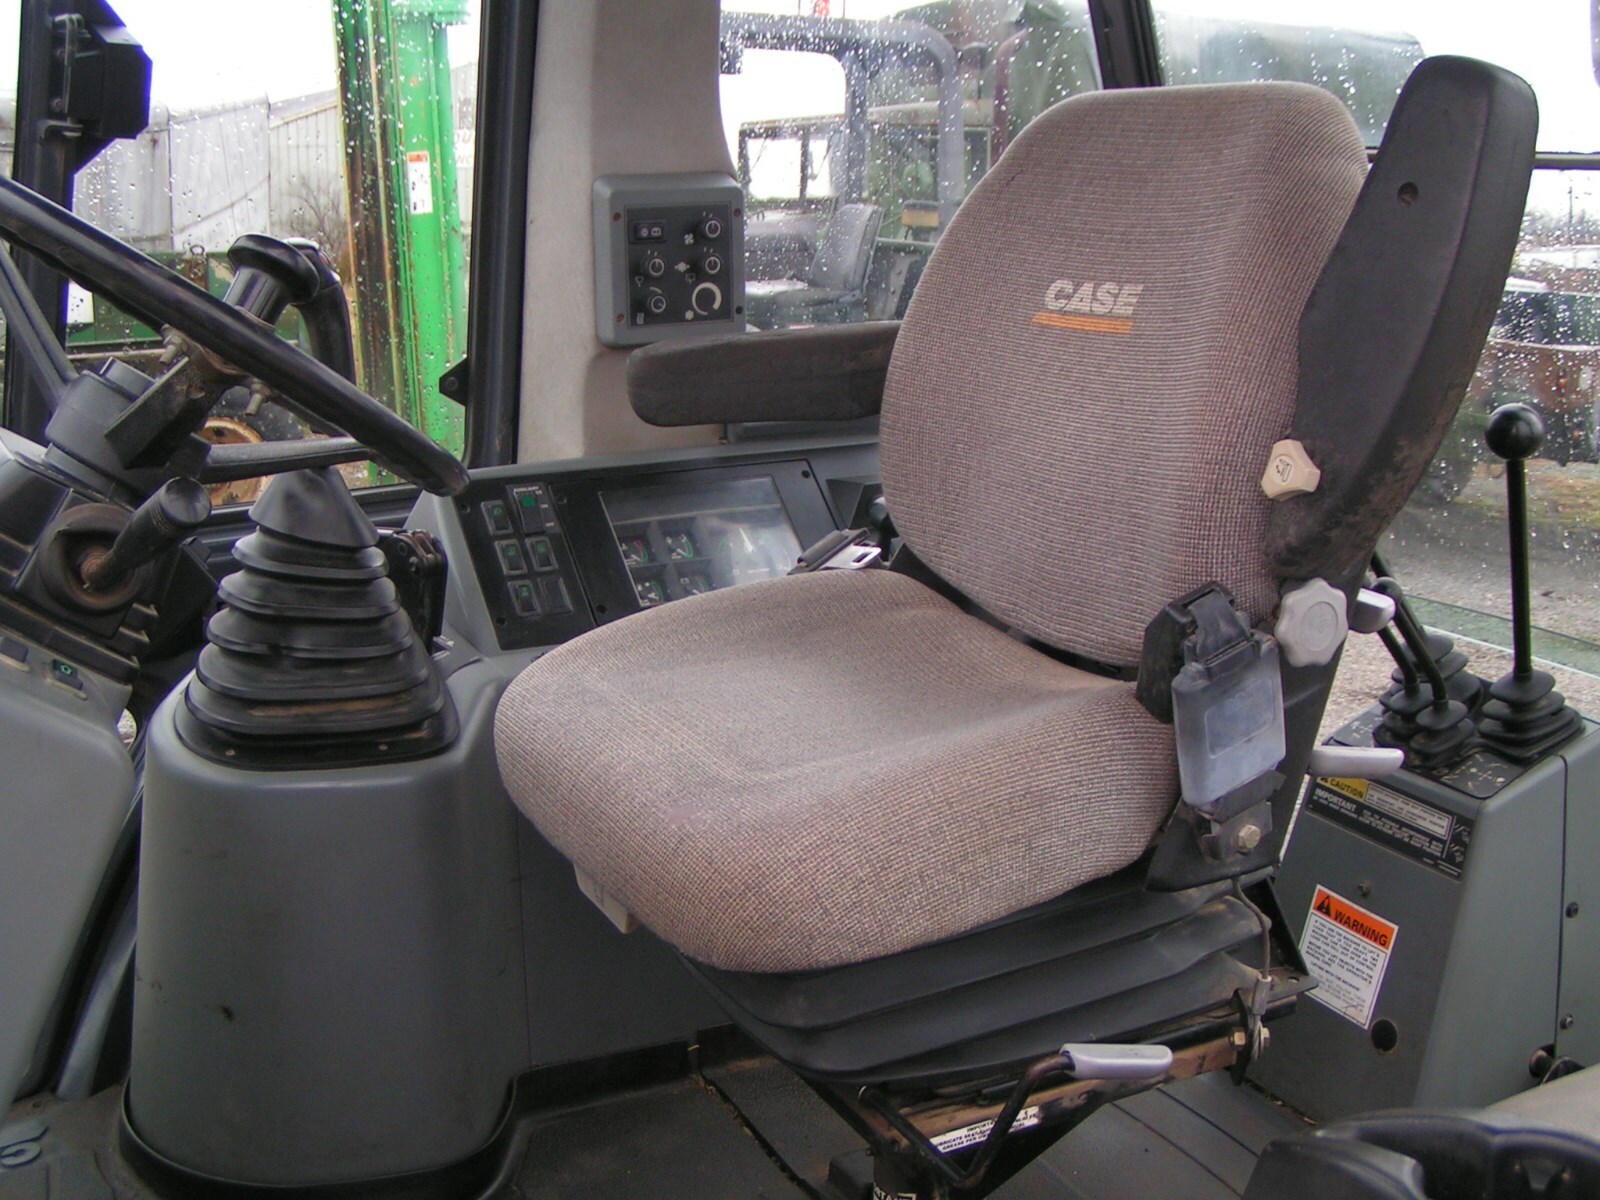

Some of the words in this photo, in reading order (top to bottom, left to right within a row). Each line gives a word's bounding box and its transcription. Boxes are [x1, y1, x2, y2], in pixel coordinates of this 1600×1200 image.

[1044, 280, 1144, 317] CASE
[1314, 788, 1358, 812] IMPORTANT
[1330, 777, 1363, 799] CAUTION
[1335, 910, 1388, 946] WARNING
